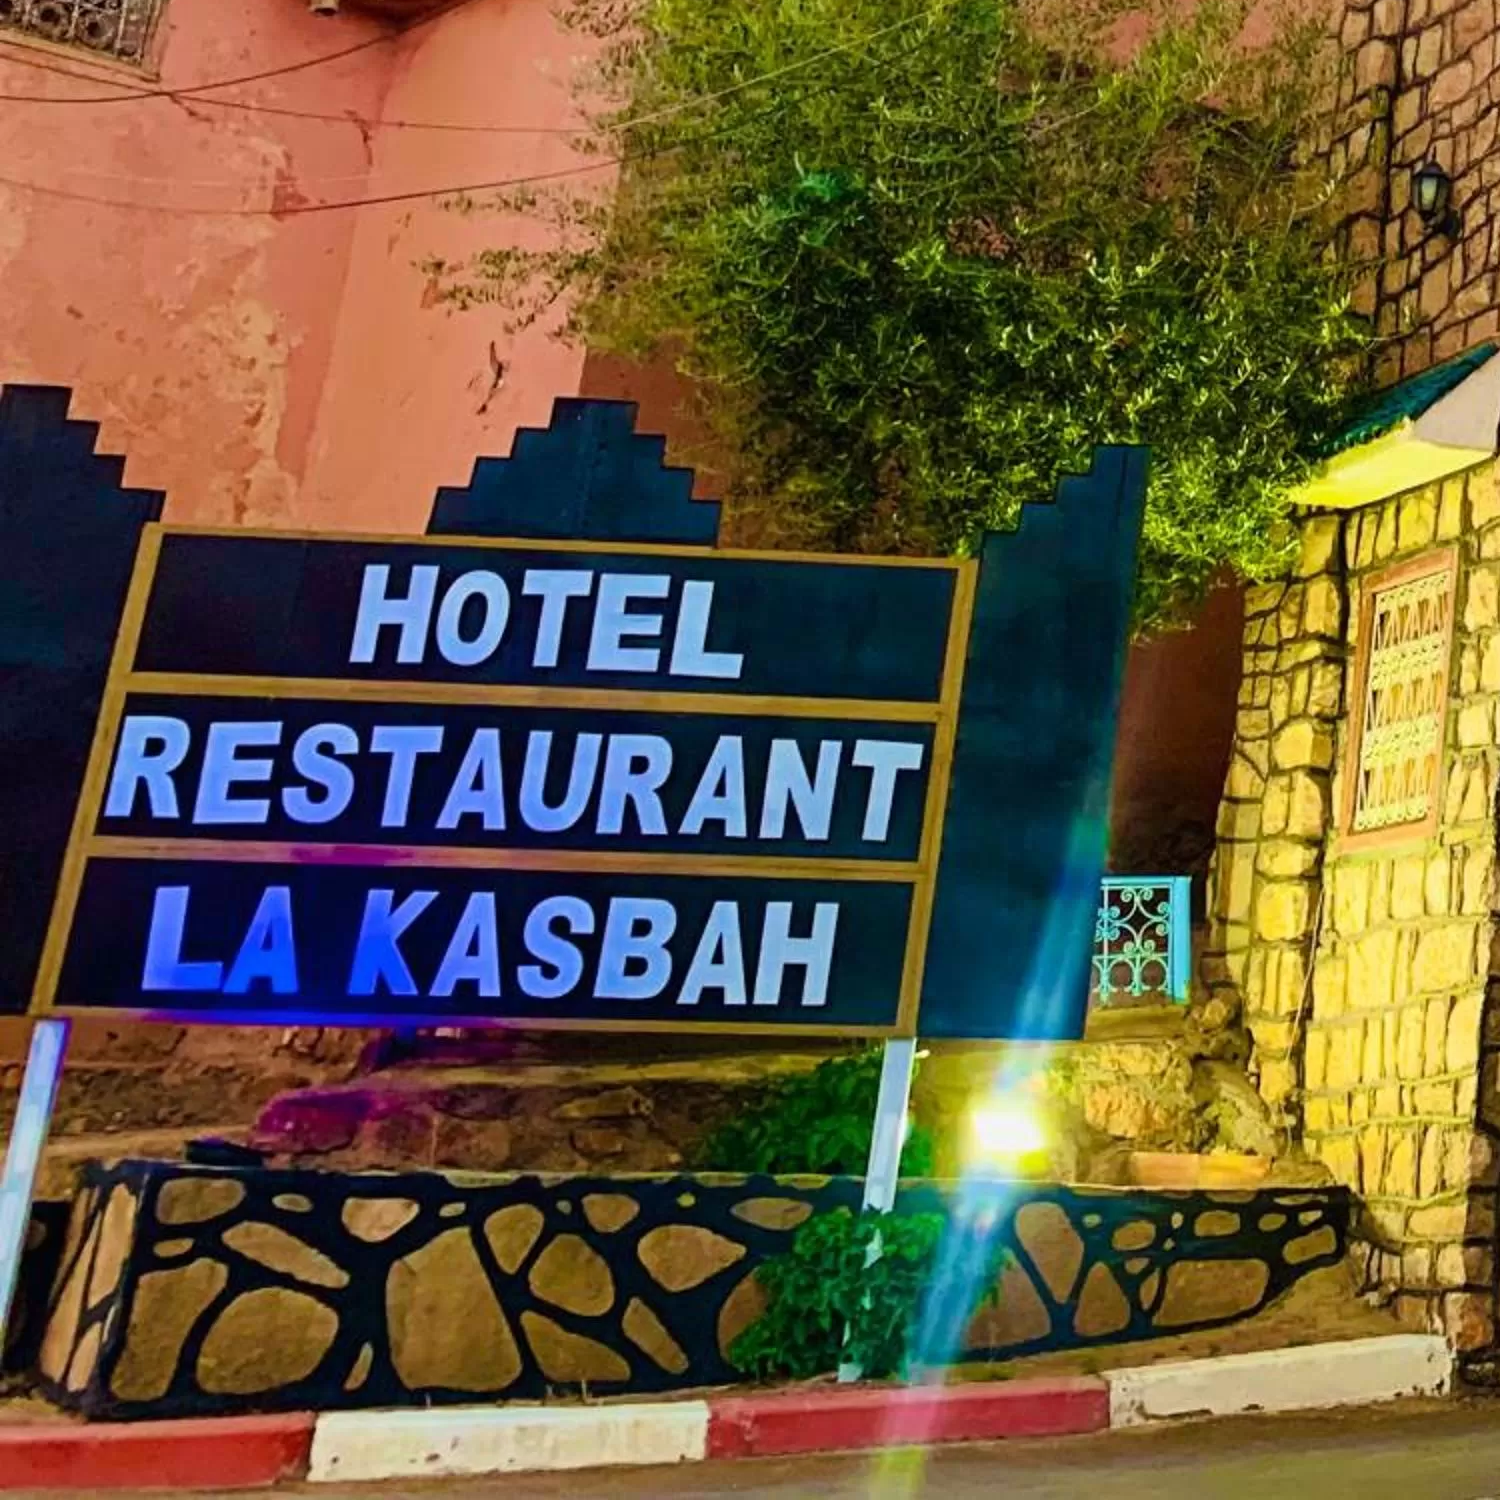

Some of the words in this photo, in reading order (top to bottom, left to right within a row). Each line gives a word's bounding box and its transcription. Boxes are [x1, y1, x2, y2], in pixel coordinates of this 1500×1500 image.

[350, 564, 743, 678] HOTEL
[104, 717, 923, 841] RESTAURANT
[142, 886, 298, 994] LA
[347, 889, 839, 1006] KASBAH
